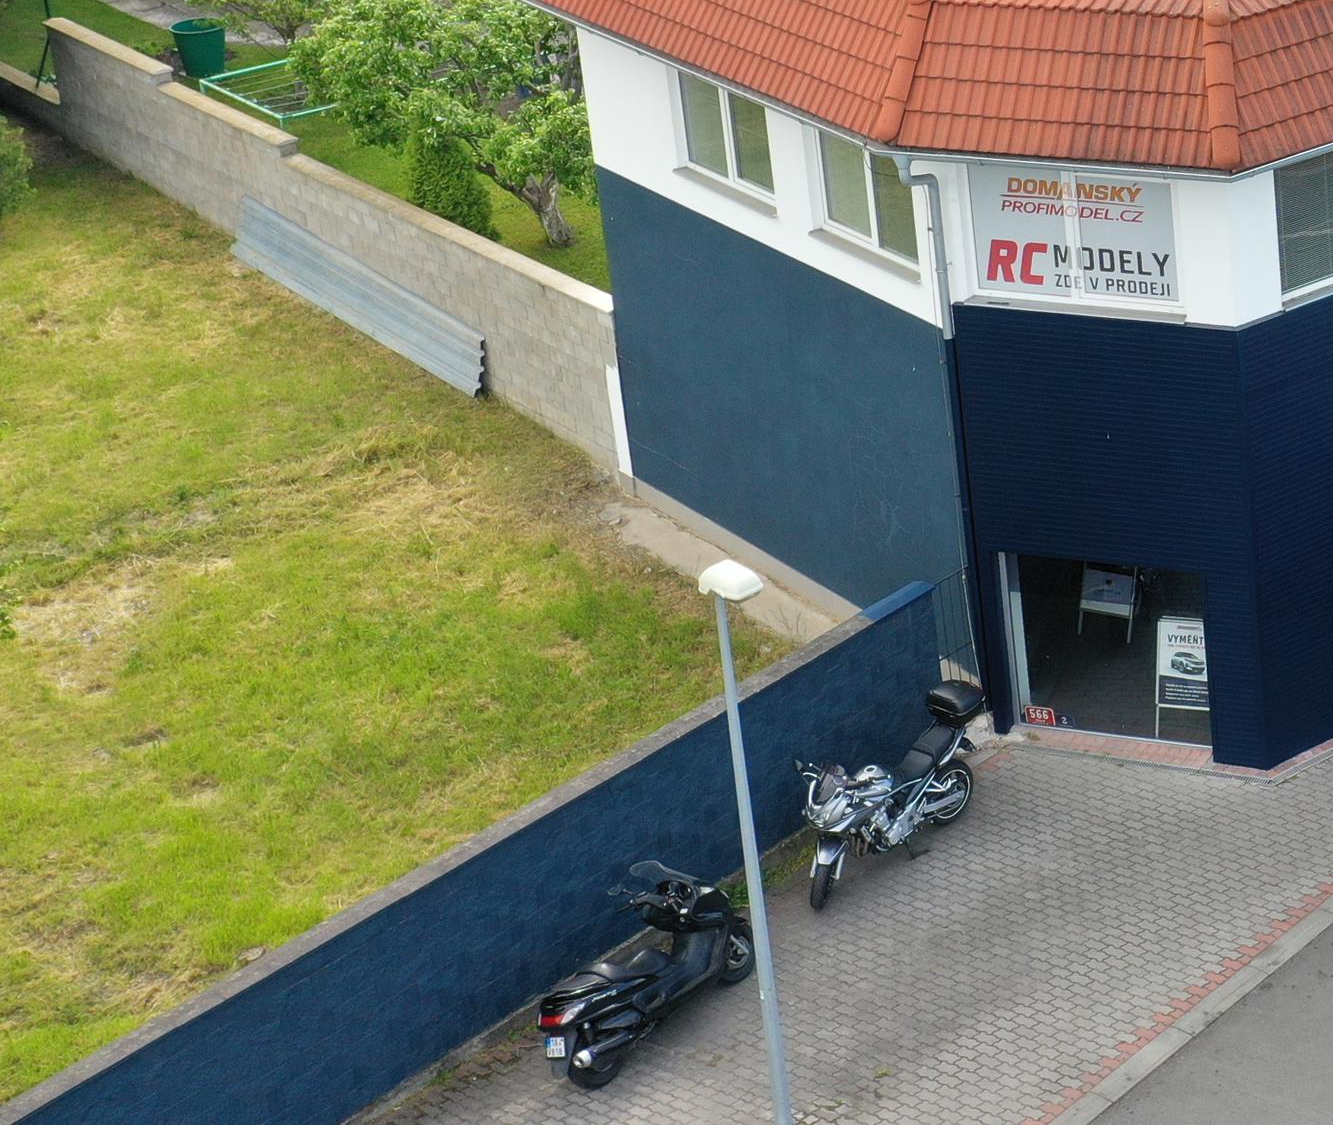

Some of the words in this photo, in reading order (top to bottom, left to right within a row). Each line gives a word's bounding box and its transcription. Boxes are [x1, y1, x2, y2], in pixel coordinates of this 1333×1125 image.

[1007, 177, 1143, 203] DOMANSKÝ
[1001, 200, 1145, 223] PROFIMODEL.CZ
[986, 239, 1050, 285] RC
[1053, 244, 1170, 277] MODELY
[1054, 274, 1082, 289] ZDE
[1089, 277, 1099, 290] V
[1106, 278, 1170, 296] PRODEJI
[1029, 709, 1049, 719] 566
[1061, 716, 1068, 725] 2
